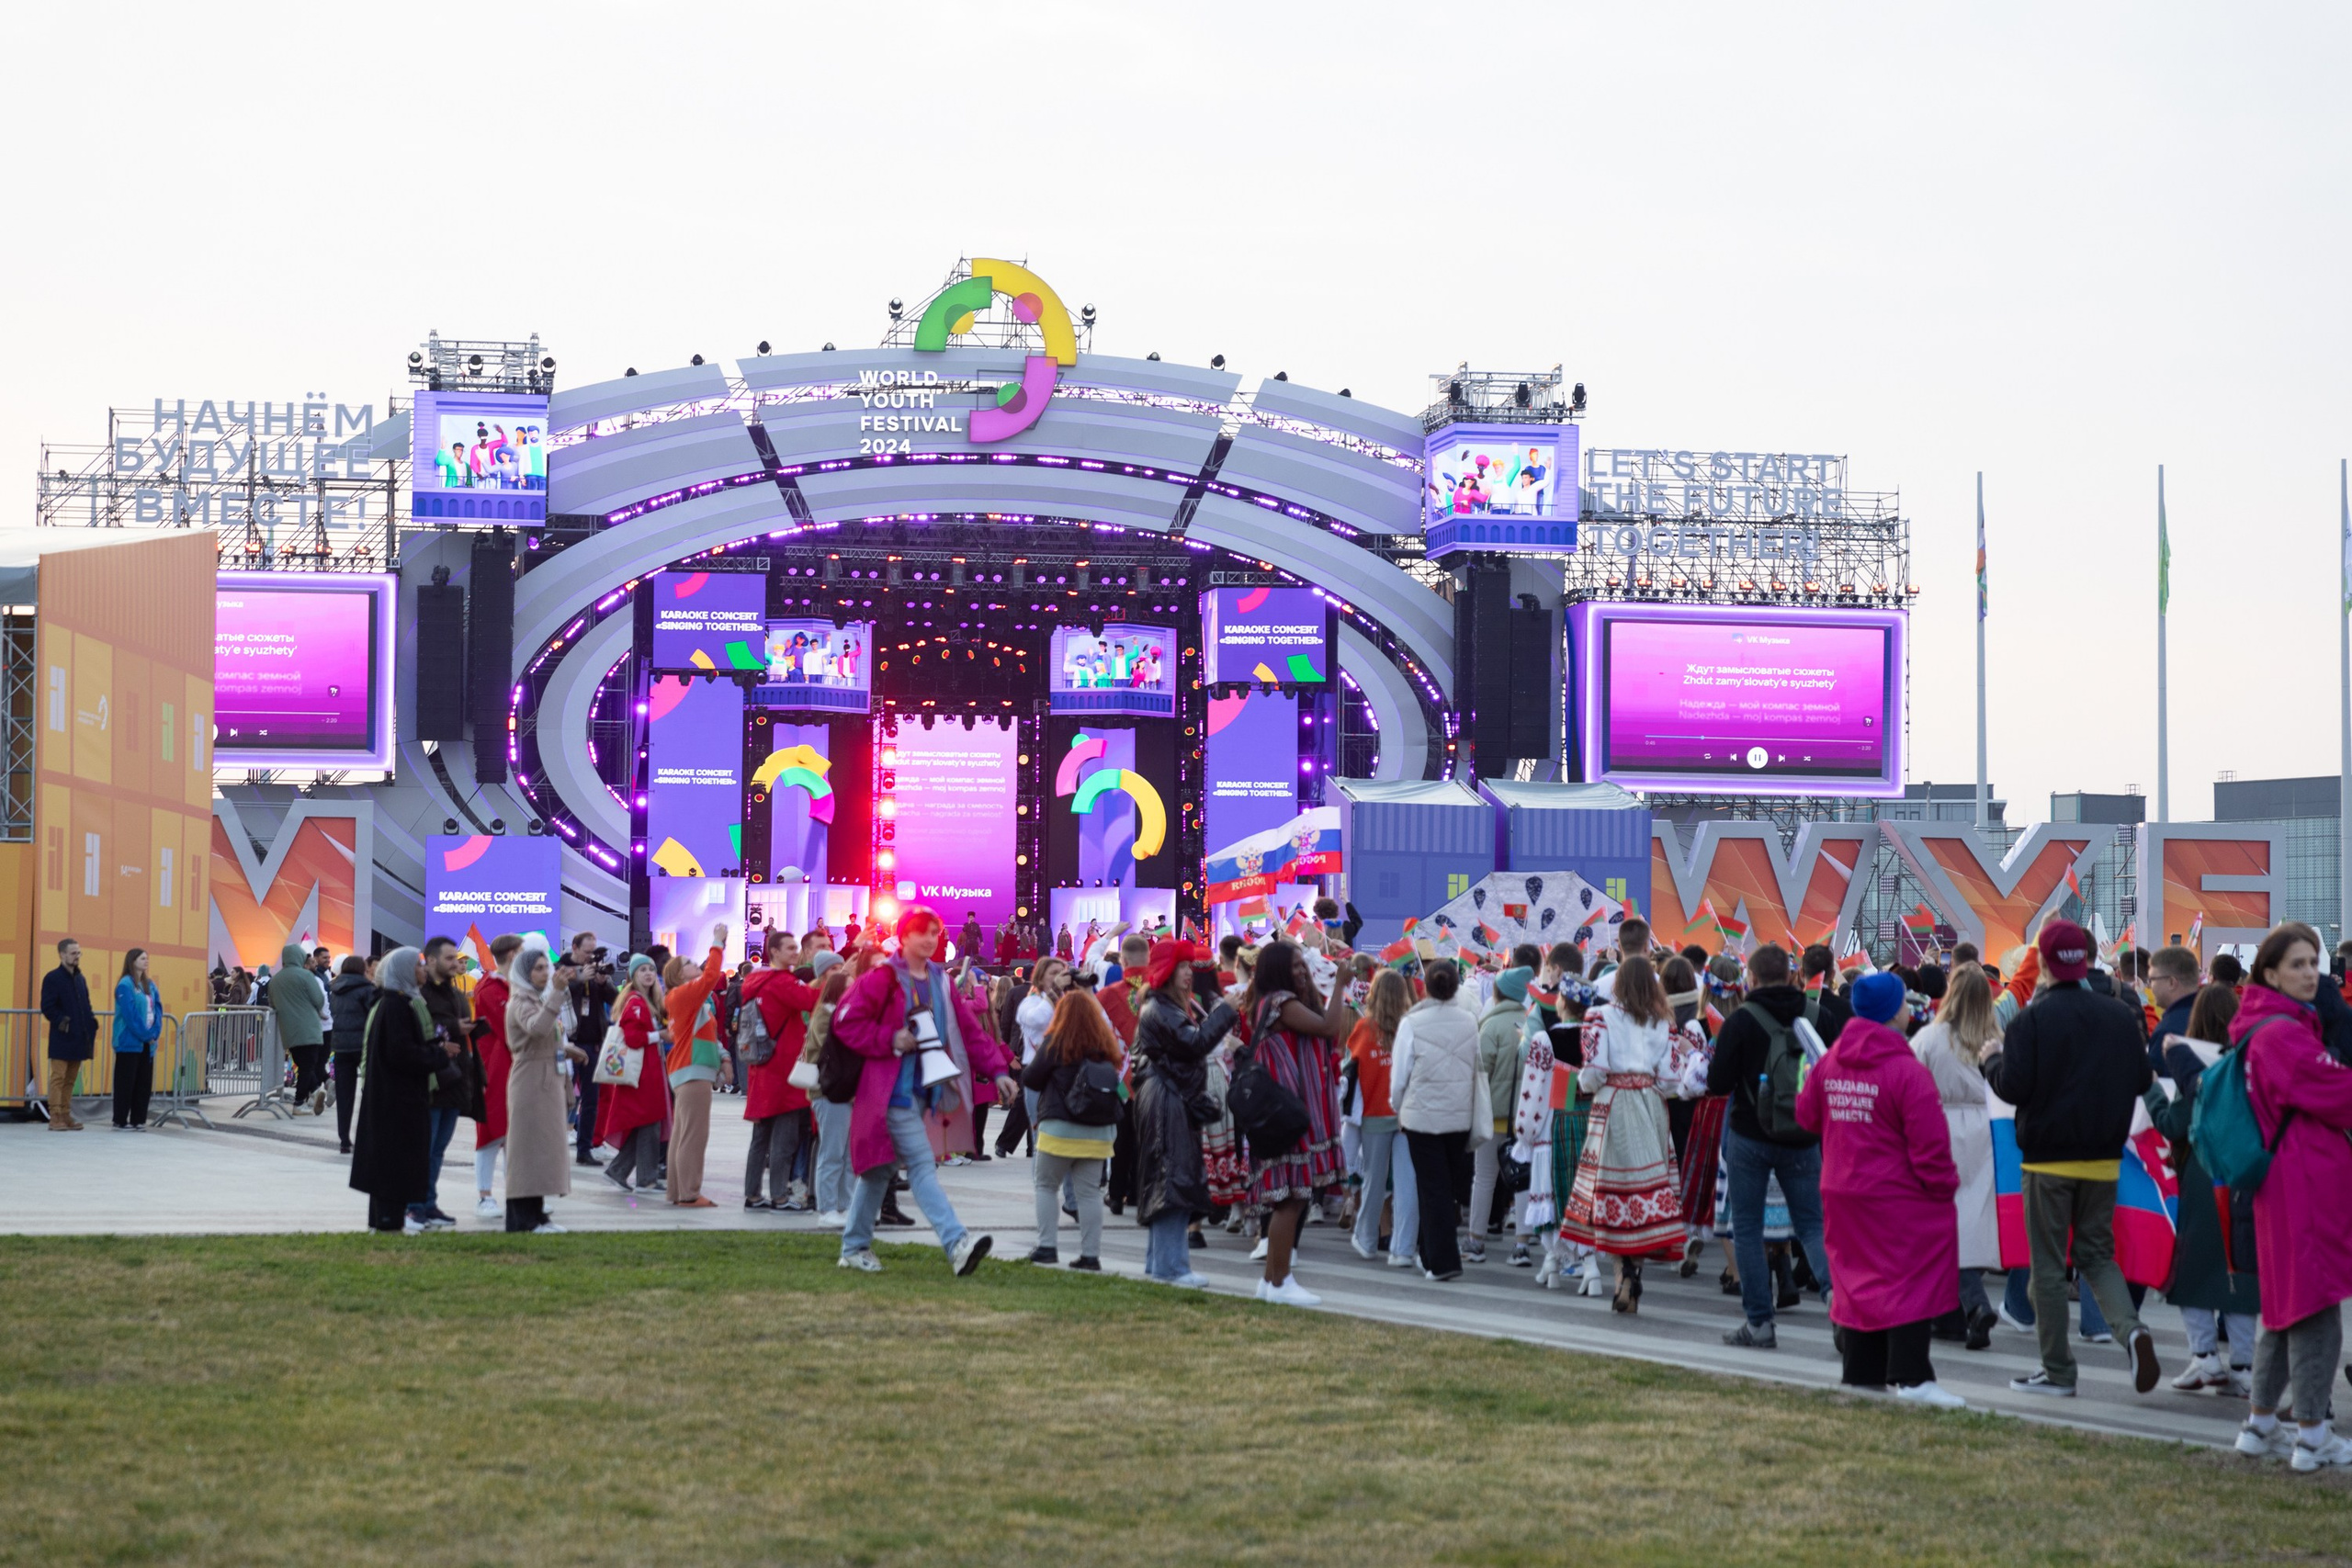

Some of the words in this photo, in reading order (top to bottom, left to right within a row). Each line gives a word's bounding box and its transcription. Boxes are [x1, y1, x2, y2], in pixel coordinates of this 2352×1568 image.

[859, 370, 938, 386] WORLD
[859, 392, 934, 409] YOUTH
[154, 391, 374, 439] НАЧНЁМ
[860, 415, 963, 433] FESTIVAL
[859, 438, 911, 454] 2024
[115, 436, 374, 486] БУДУЩЕЕ
[1588, 446, 1696, 480] LET'S
[1710, 450, 1836, 483] START
[1588, 482, 1668, 514] THE
[1683, 484, 1844, 518] FUTURE
[135, 488, 367, 531] ВМЕСТЕ!
[1588, 525, 1821, 559] TOGETHER!
[217, 601, 244, 609] узыка
[661, 610, 708, 620] KARAOKE
[710, 611, 759, 620] CONCERT
[1224, 625, 1271, 634] KARAOKE
[1272, 625, 1319, 634] CONCERT
[216, 633, 244, 642] атые
[247, 634, 295, 643] сюжеты
[1747, 636, 1758, 644] VK
[257, 670, 301, 681] земной
[1686, 663, 1715, 674] Ждут
[1716, 666, 1792, 677] замысловатые
[1793, 668, 1835, 677] сюжеты
[1683, 675, 1714, 685] Zhdut
[261, 683, 302, 695] zemnoj
[1679, 699, 1726, 710] Надежда
[1739, 701, 1760, 710] мой
[1762, 702, 1799, 711] компас
[1803, 702, 1840, 712] земной
[1679, 710, 1730, 720] Nadezhda
[1743, 712, 1762, 724] moj
[1764, 712, 1803, 723] kompas
[1805, 714, 1841, 725] zemnoj
[657, 768, 695, 776] KARAOKE
[695, 769, 734, 777] CONCERT
[1253, 781, 1290, 789] CONCERT
[438, 891, 492, 901] KARAOKE
[493, 892, 548, 901] CONCERT
[921, 886, 940, 897] VK
[942, 886, 992, 899] Музыка
